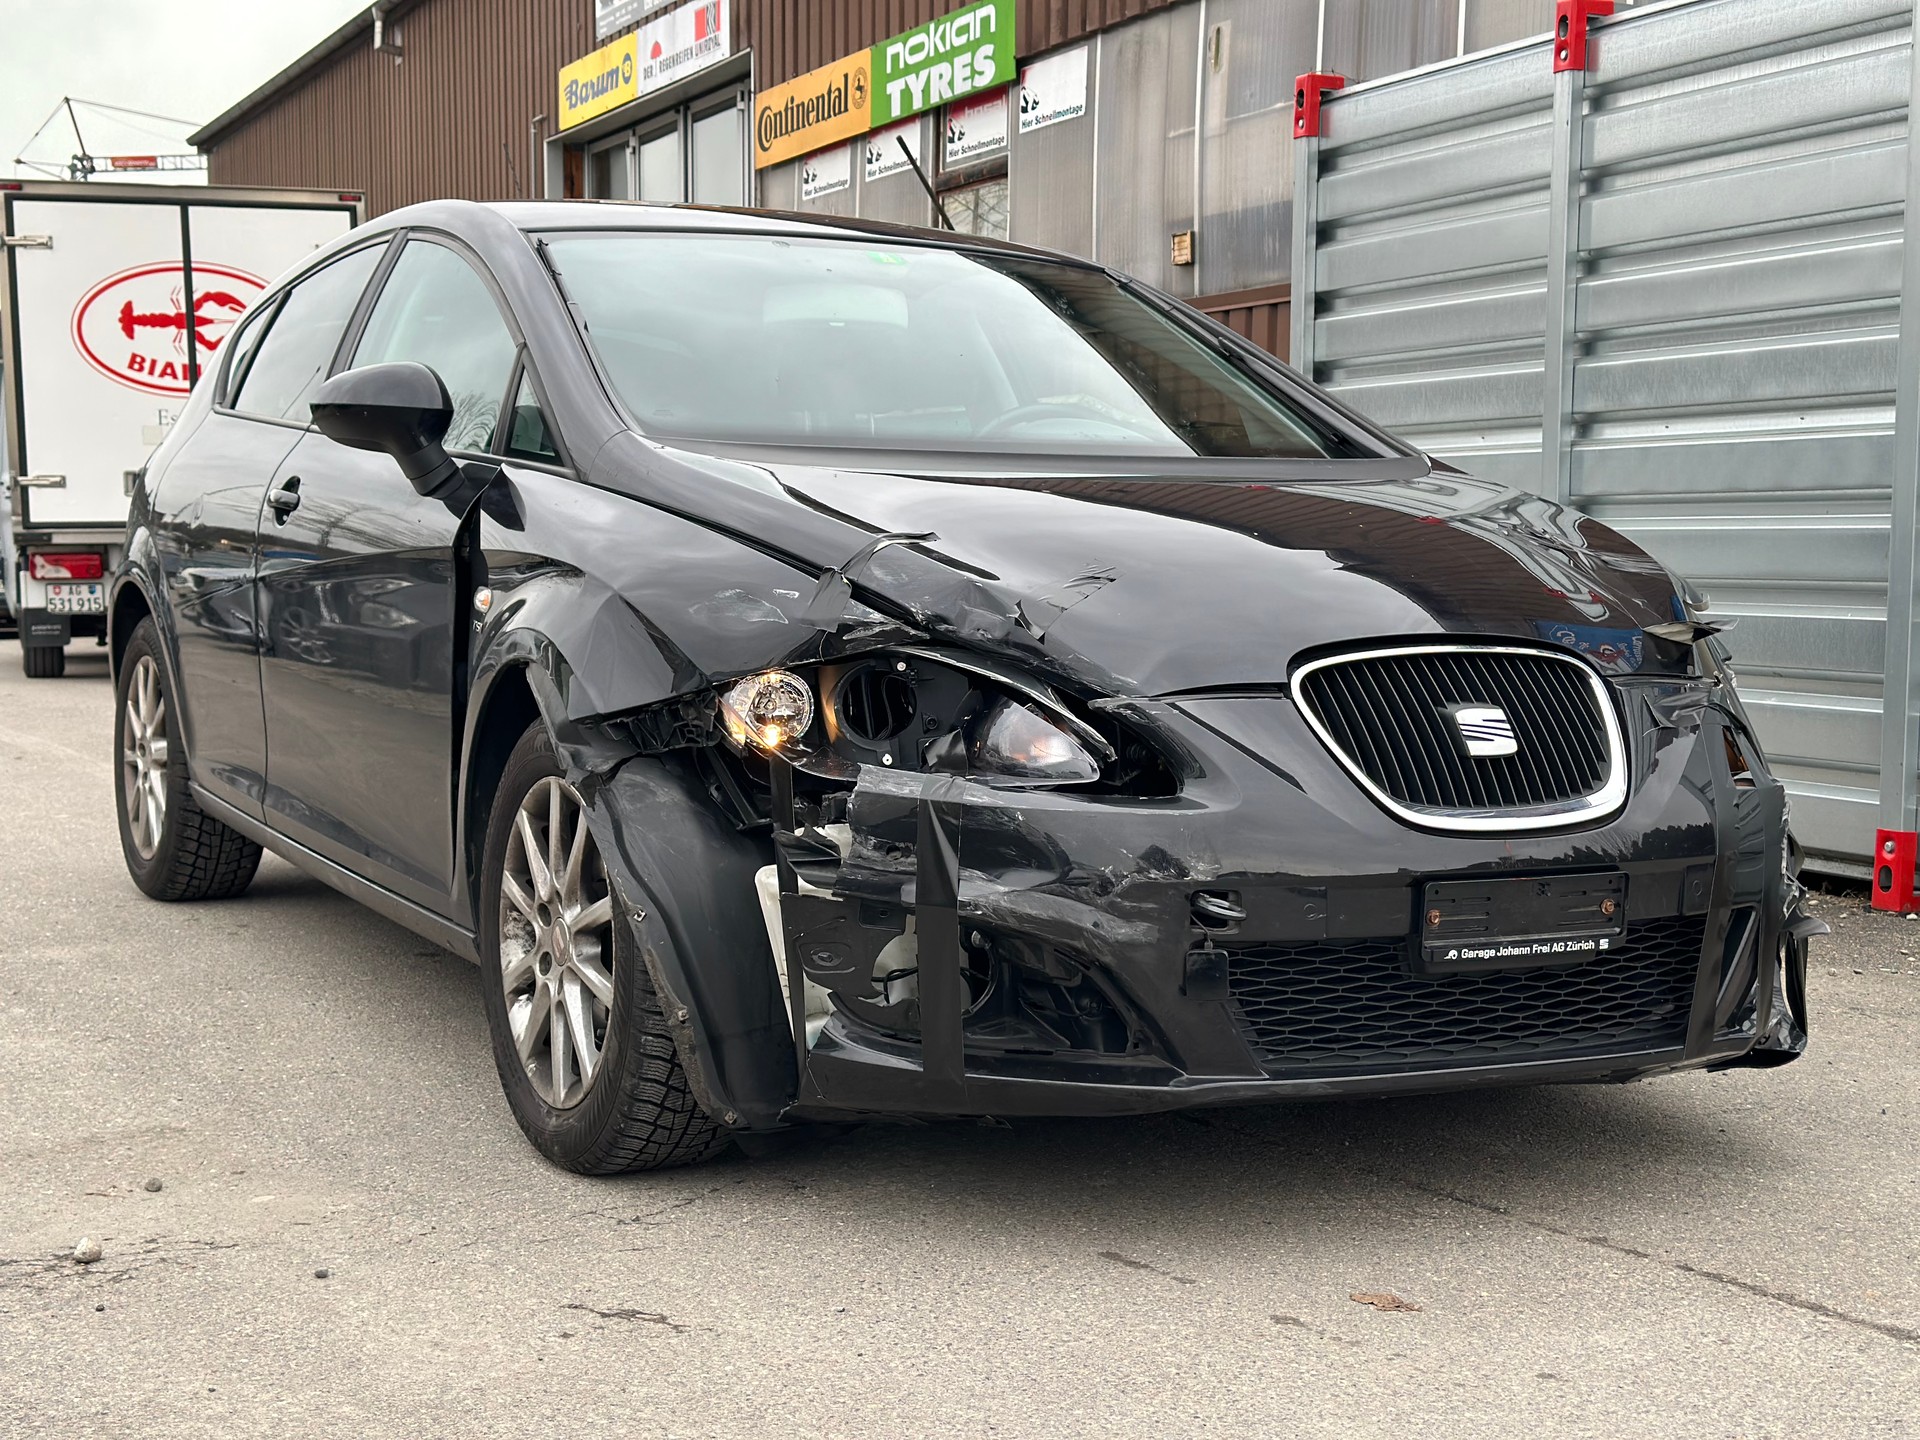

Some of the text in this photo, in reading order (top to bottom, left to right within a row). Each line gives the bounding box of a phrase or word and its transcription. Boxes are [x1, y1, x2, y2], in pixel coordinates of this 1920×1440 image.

[643, 34, 721, 81] DER REGENREIFEN UNIROYAL
[564, 66, 620, 110] Barum
[886, 44, 996, 118] TYRES
[757, 73, 849, 152] Continental
[1021, 104, 1083, 129] Hier Schnellmontage
[948, 136, 1005, 158] Hier Schnellmontage
[69, 585, 82, 596] AG
[1461, 949, 1496, 960] Garage
[1497, 945, 1531, 957] Johann
[1532, 943, 1551, 954] Frei
[1552, 943, 1565, 953] AG
[1567, 939, 1595, 951] Zürich
